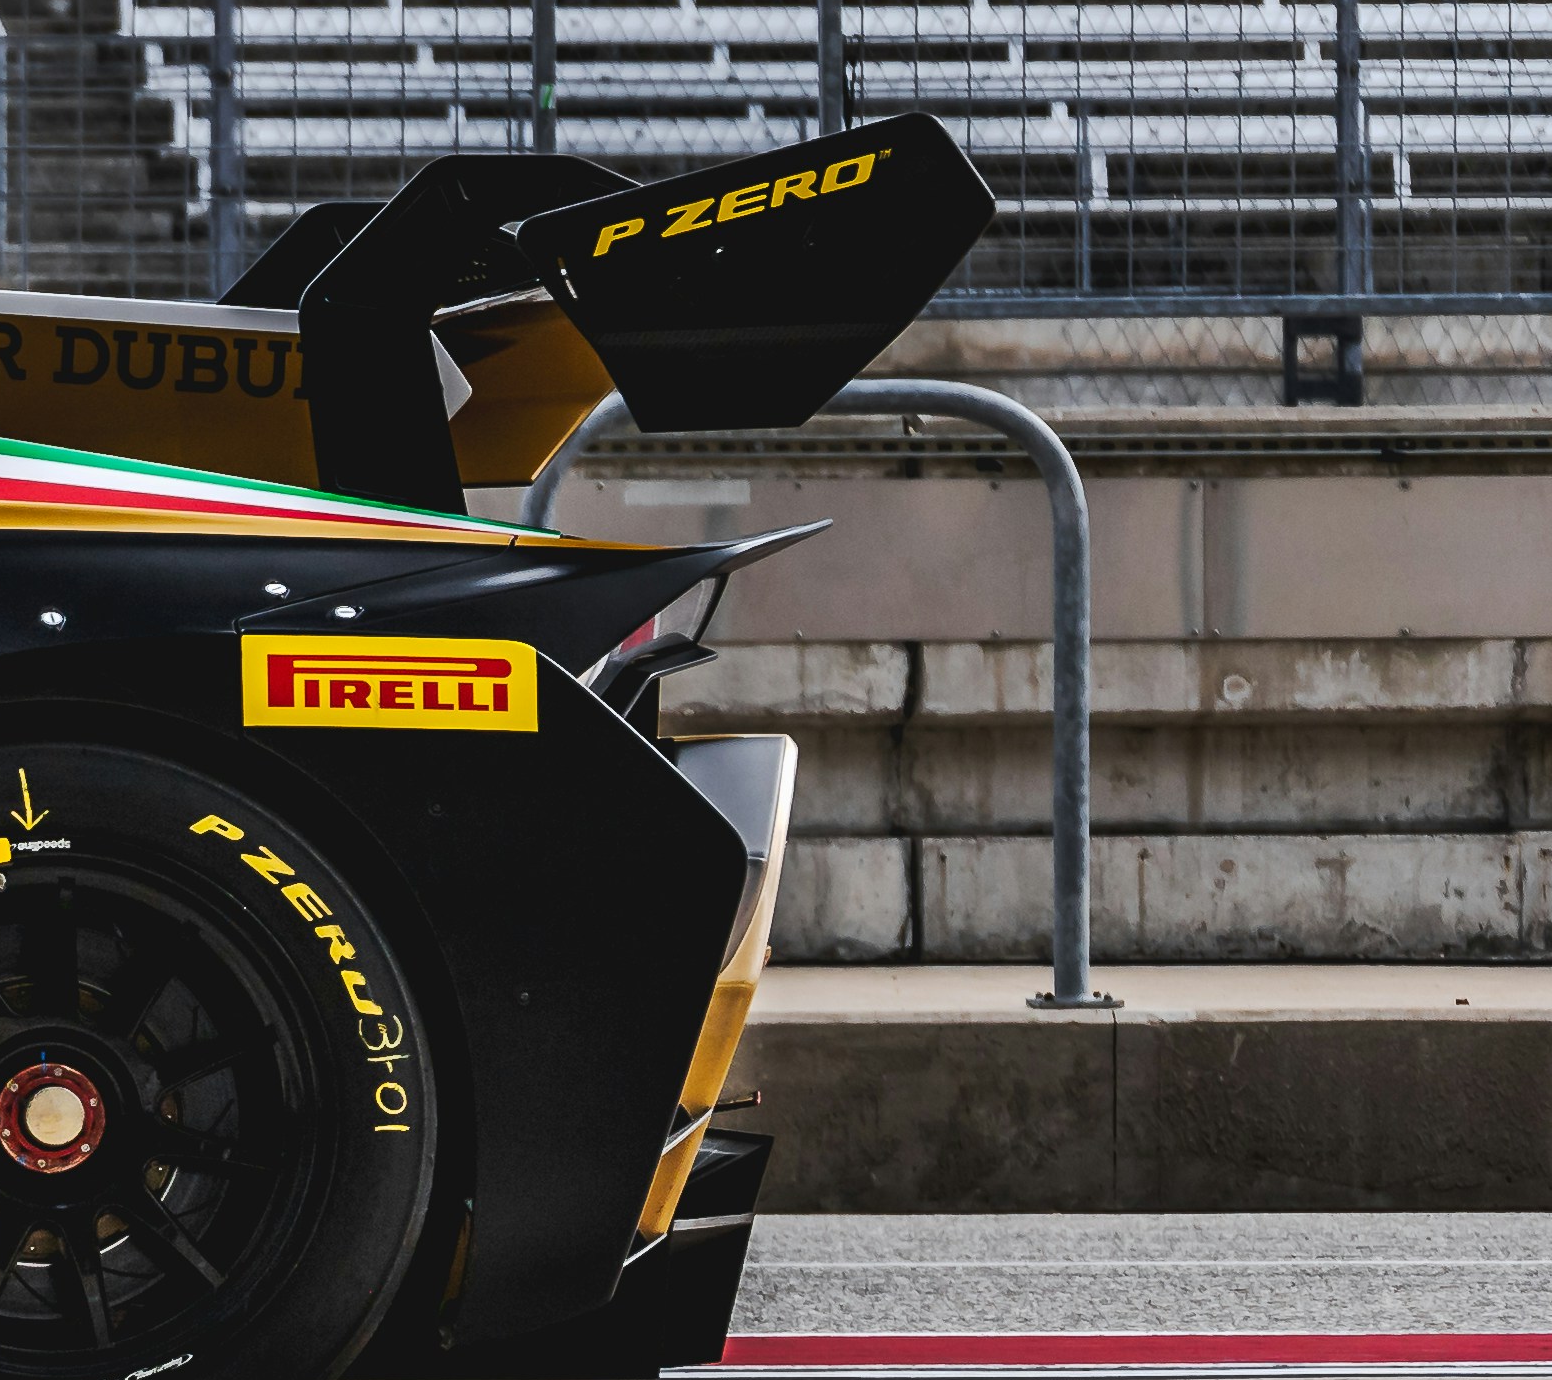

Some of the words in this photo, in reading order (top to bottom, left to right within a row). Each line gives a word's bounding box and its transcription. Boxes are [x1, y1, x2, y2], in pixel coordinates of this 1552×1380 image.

[593, 218, 644, 256] P
[53, 324, 307, 401] DUBU
[267, 654, 512, 711] PIRELLI
